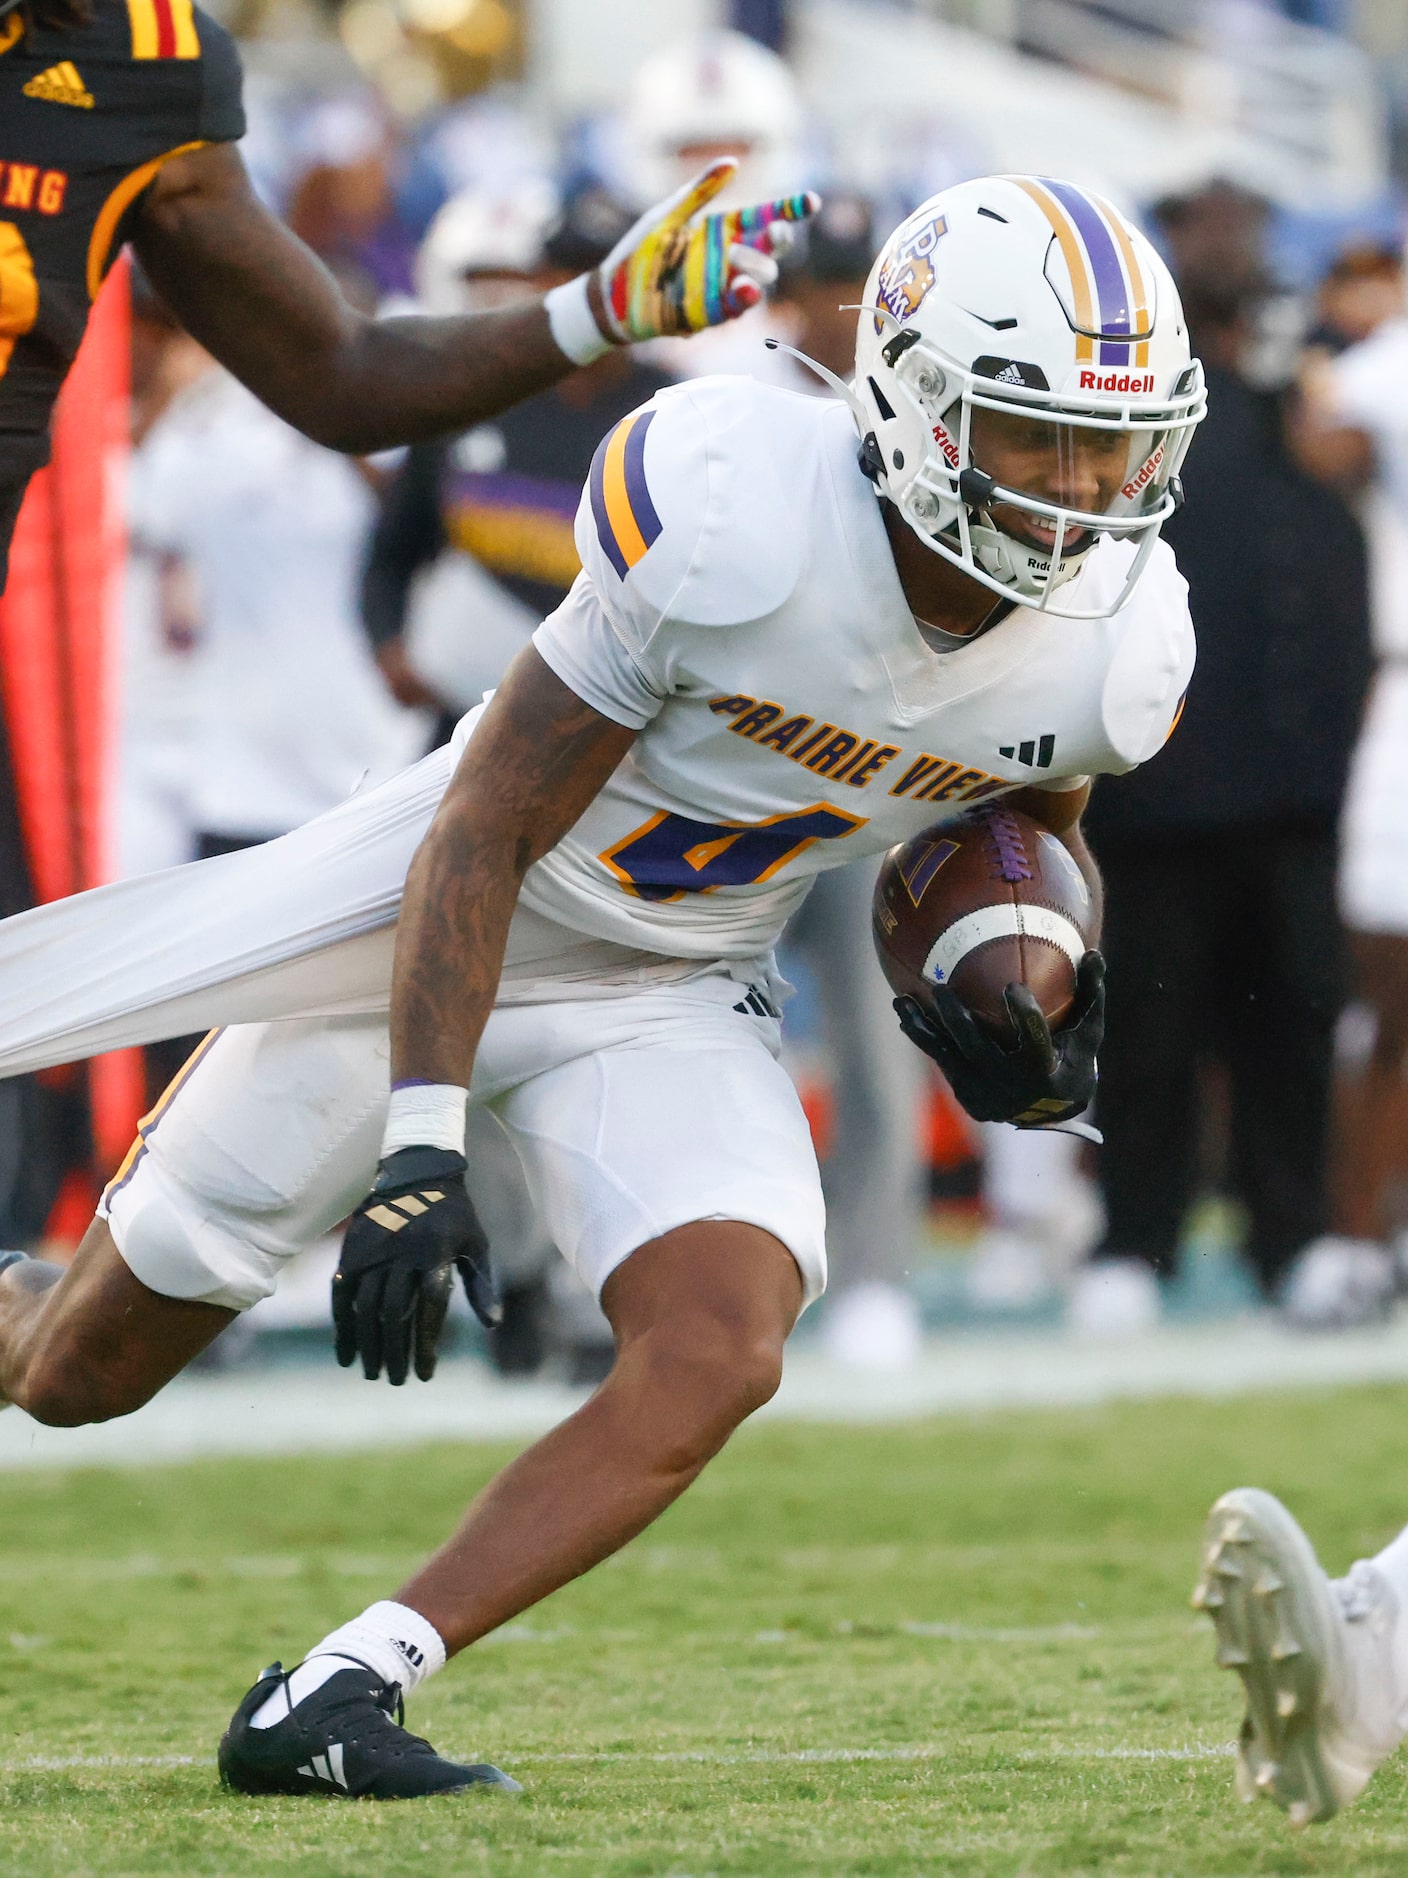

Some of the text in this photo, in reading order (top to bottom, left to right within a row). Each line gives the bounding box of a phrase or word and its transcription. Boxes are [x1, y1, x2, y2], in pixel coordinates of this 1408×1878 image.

[994, 373, 1026, 386] adidas
[1080, 370, 1155, 393] Riddell
[932, 425, 960, 468] Ridd
[1121, 445, 1168, 501] Ridde
[1027, 557, 1066, 572] Ridll
[708, 693, 902, 788] PRAIRIE
[597, 800, 871, 904] 4
